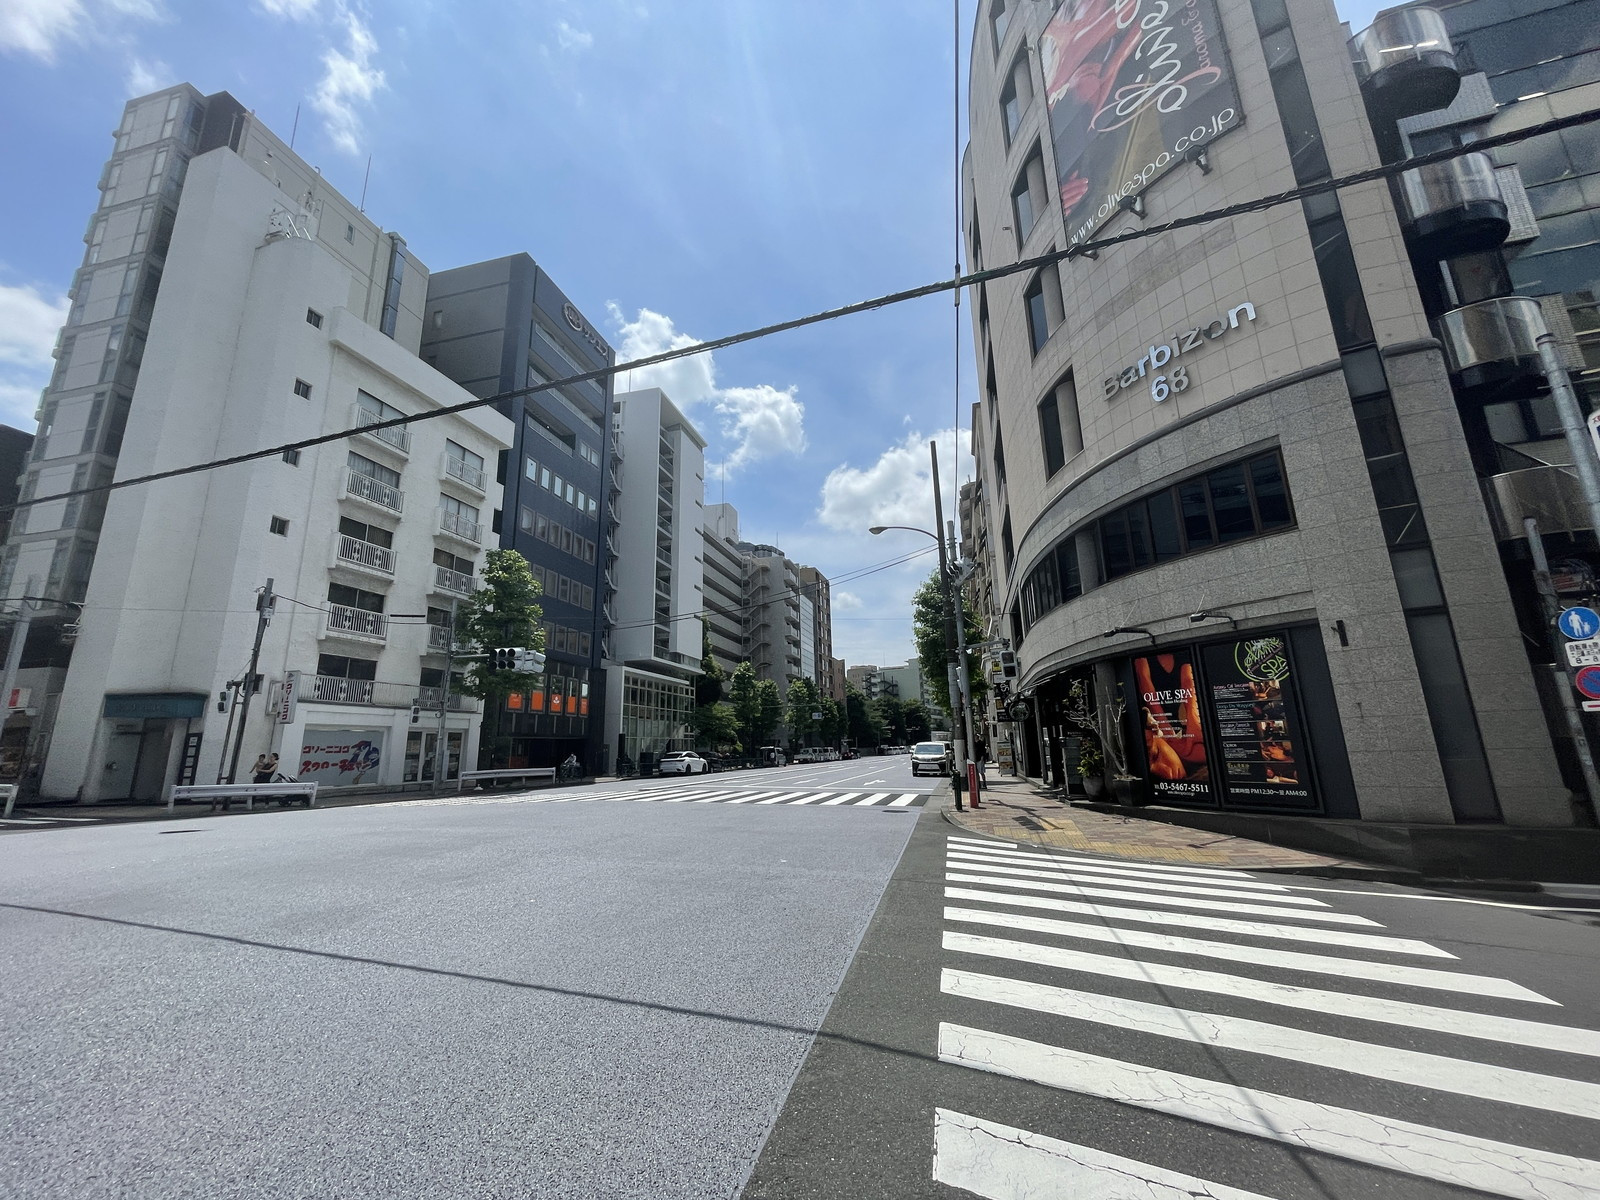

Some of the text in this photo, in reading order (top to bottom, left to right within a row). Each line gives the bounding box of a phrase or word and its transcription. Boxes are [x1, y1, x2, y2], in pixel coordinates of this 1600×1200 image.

[1191, 25, 1212, 68] aroma
[1103, 301, 1257, 401] Barbizon
[1151, 366, 1190, 402] 68
[1261, 655, 1287, 678] SPA
[282, 683, 293, 720] クリーニング
[1143, 688, 1193, 702] OLIVE SPA
[302, 745, 351, 754] クリーニング
[1160, 782, 1209, 793] 03-5467-5511
